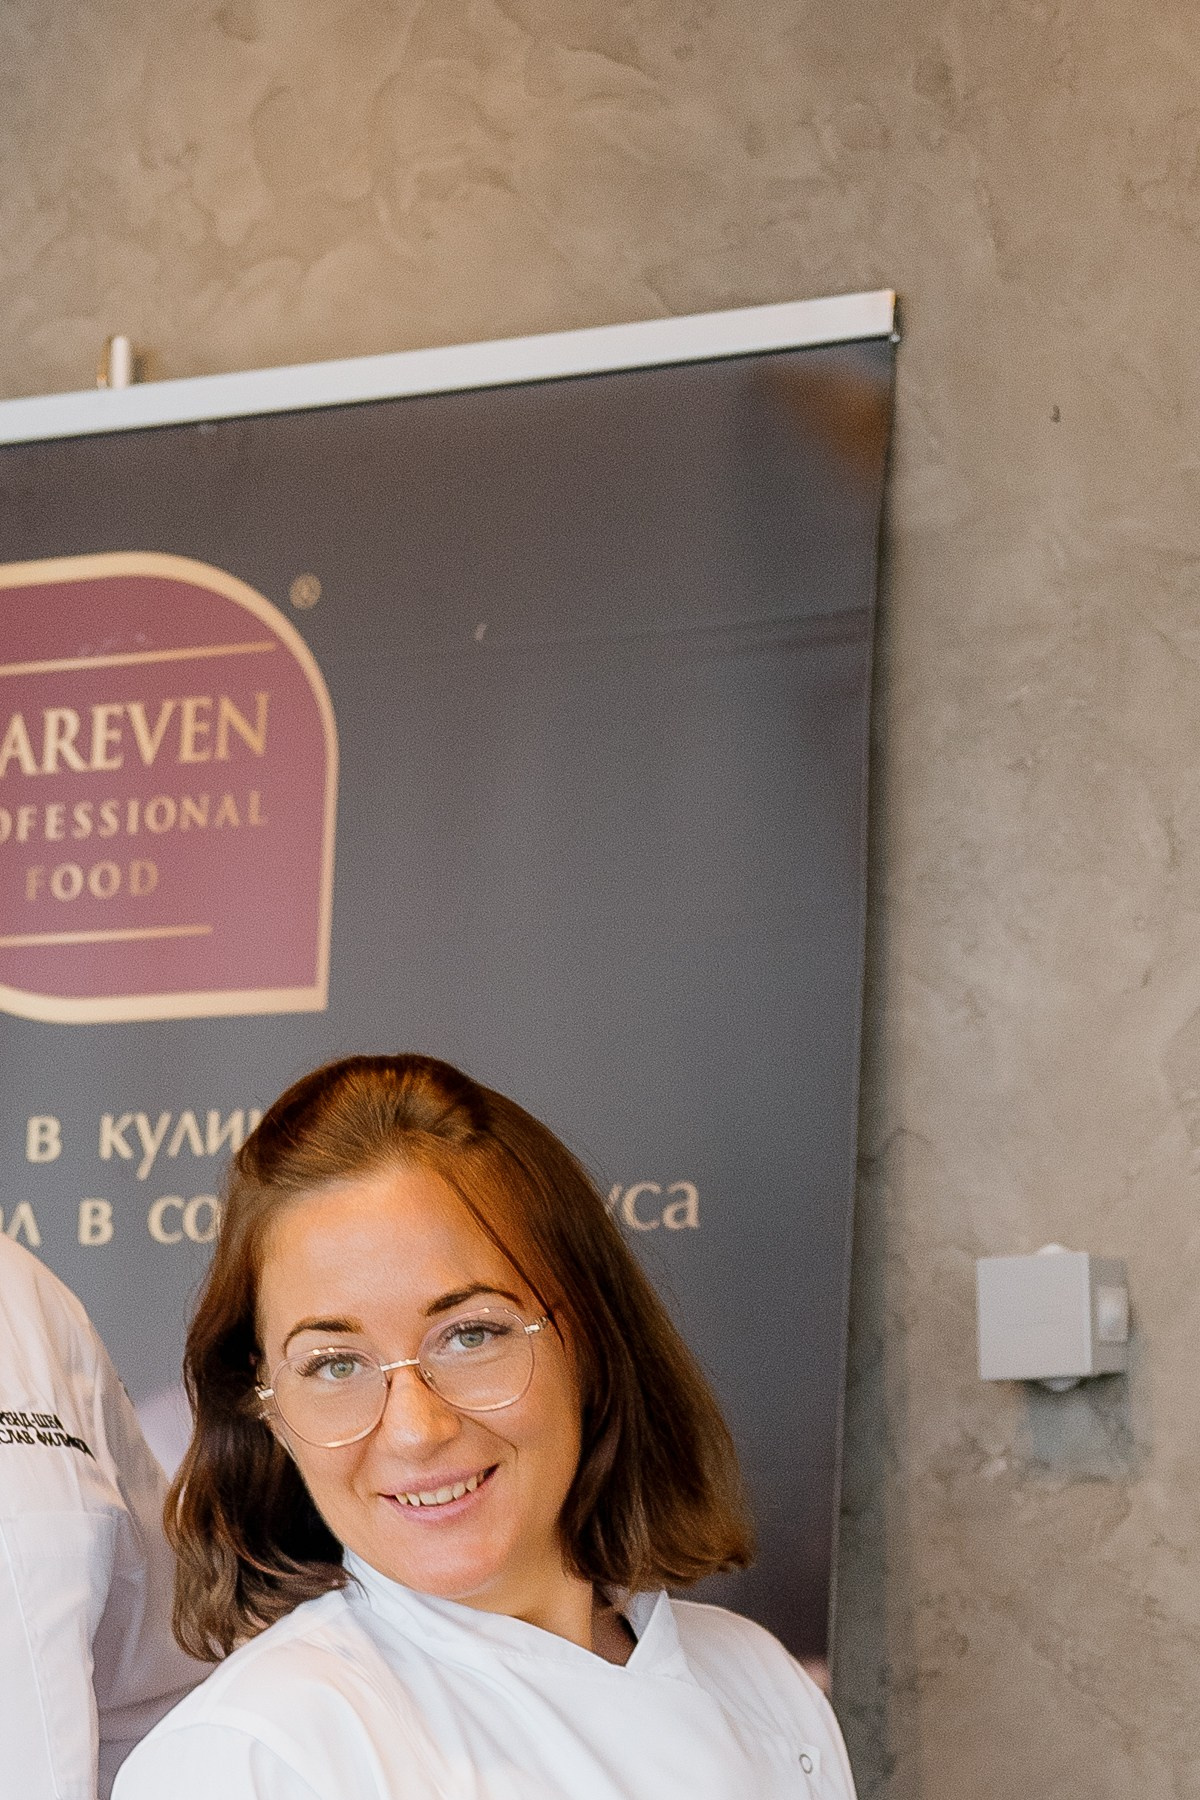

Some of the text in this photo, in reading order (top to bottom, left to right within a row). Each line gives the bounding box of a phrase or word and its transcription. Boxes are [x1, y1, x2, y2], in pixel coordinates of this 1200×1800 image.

[25, 857, 160, 902] FOOD
[25, 1114, 63, 1165] в
[76, 1197, 116, 1248] в
